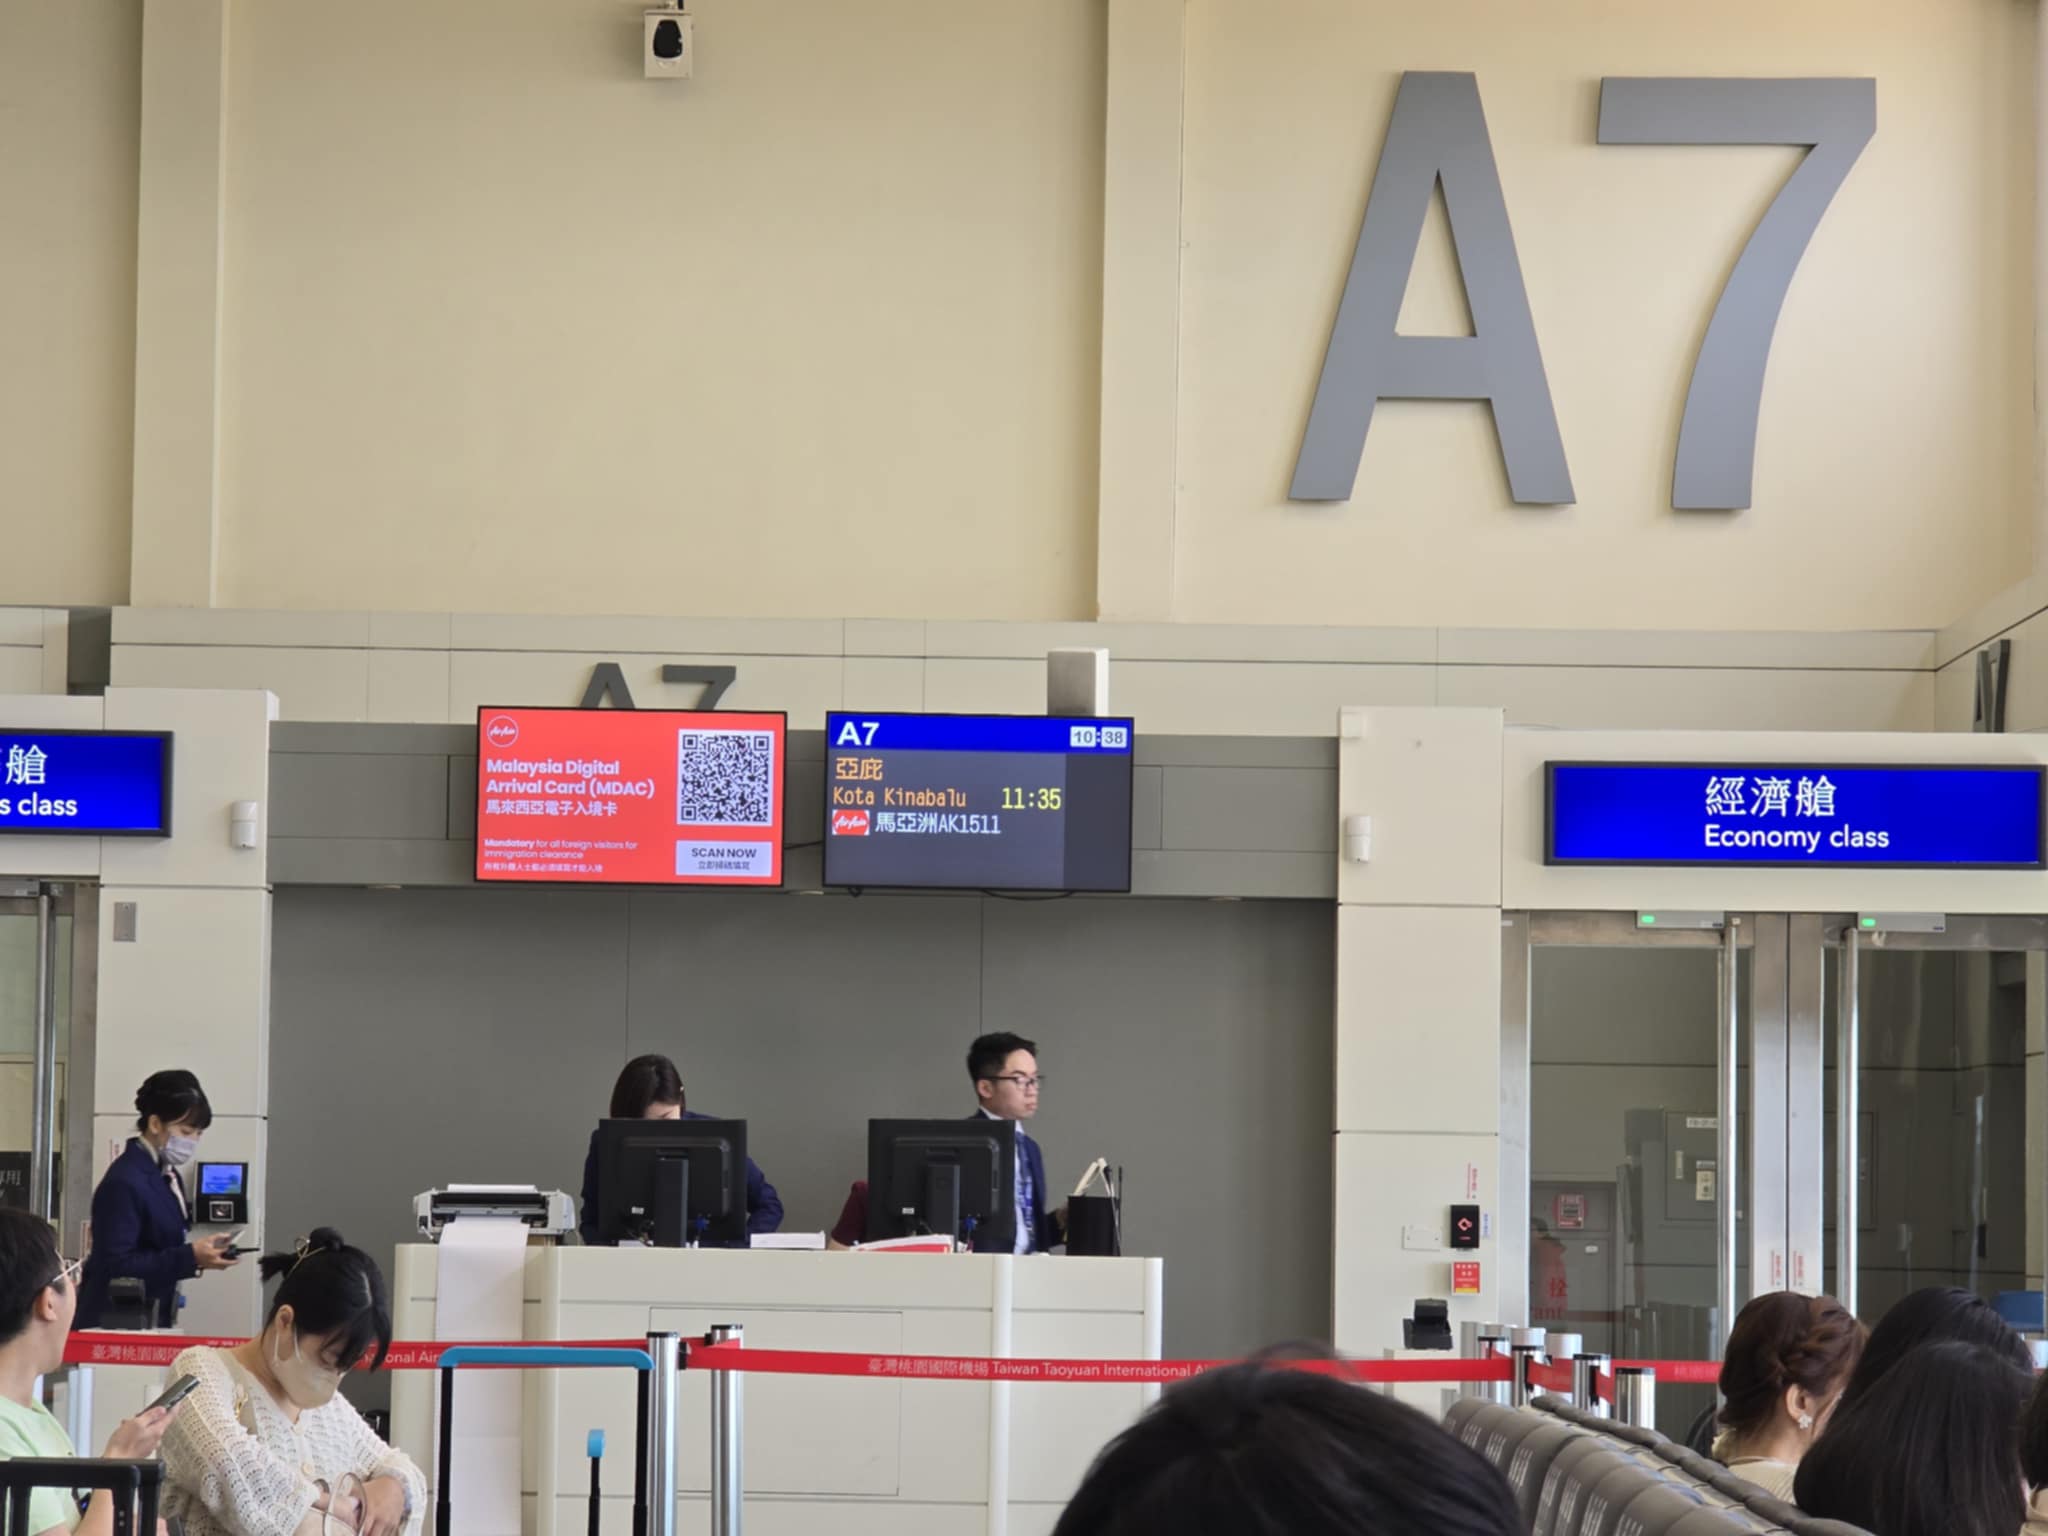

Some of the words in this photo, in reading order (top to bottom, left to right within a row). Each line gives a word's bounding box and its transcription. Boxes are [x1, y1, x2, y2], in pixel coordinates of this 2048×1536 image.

[1288, 71, 1877, 510] A7
[836, 721, 880, 746] A7
[1073, 730, 1125, 745] 10:38
[0, 744, 48, 786] 艙
[486, 759, 562, 778] Malaysia
[565, 760, 620, 779] Digital
[835, 757, 884, 782] 亞庇
[486, 778, 541, 794] Arrival
[544, 780, 586, 795] Card
[589, 778, 655, 799] (MDAC)
[833, 787, 875, 806] Kota
[884, 787, 967, 807] Kinabalu
[1002, 787, 1062, 809] 11:35
[1704, 775, 1837, 818] 經濟艙
[17, 791, 78, 816] class
[486, 800, 618, 817] 馬來西亞電子入境卡
[484, 838, 534, 850] Mandatory
[536, 839, 548, 848] for
[561, 840, 592, 851] foreign
[594, 841, 624, 849] visitors
[625, 841, 638, 849] for
[1704, 823, 1821, 852] Economy
[1830, 823, 1890, 848] class
[691, 847, 725, 858] SCAN
[727, 848, 757, 858] NOW
[992, 1361, 1040, 1375] Taiwan
[1042, 1362, 1100, 1379] Taoyuan
[1104, 1363, 1191, 1377] International
